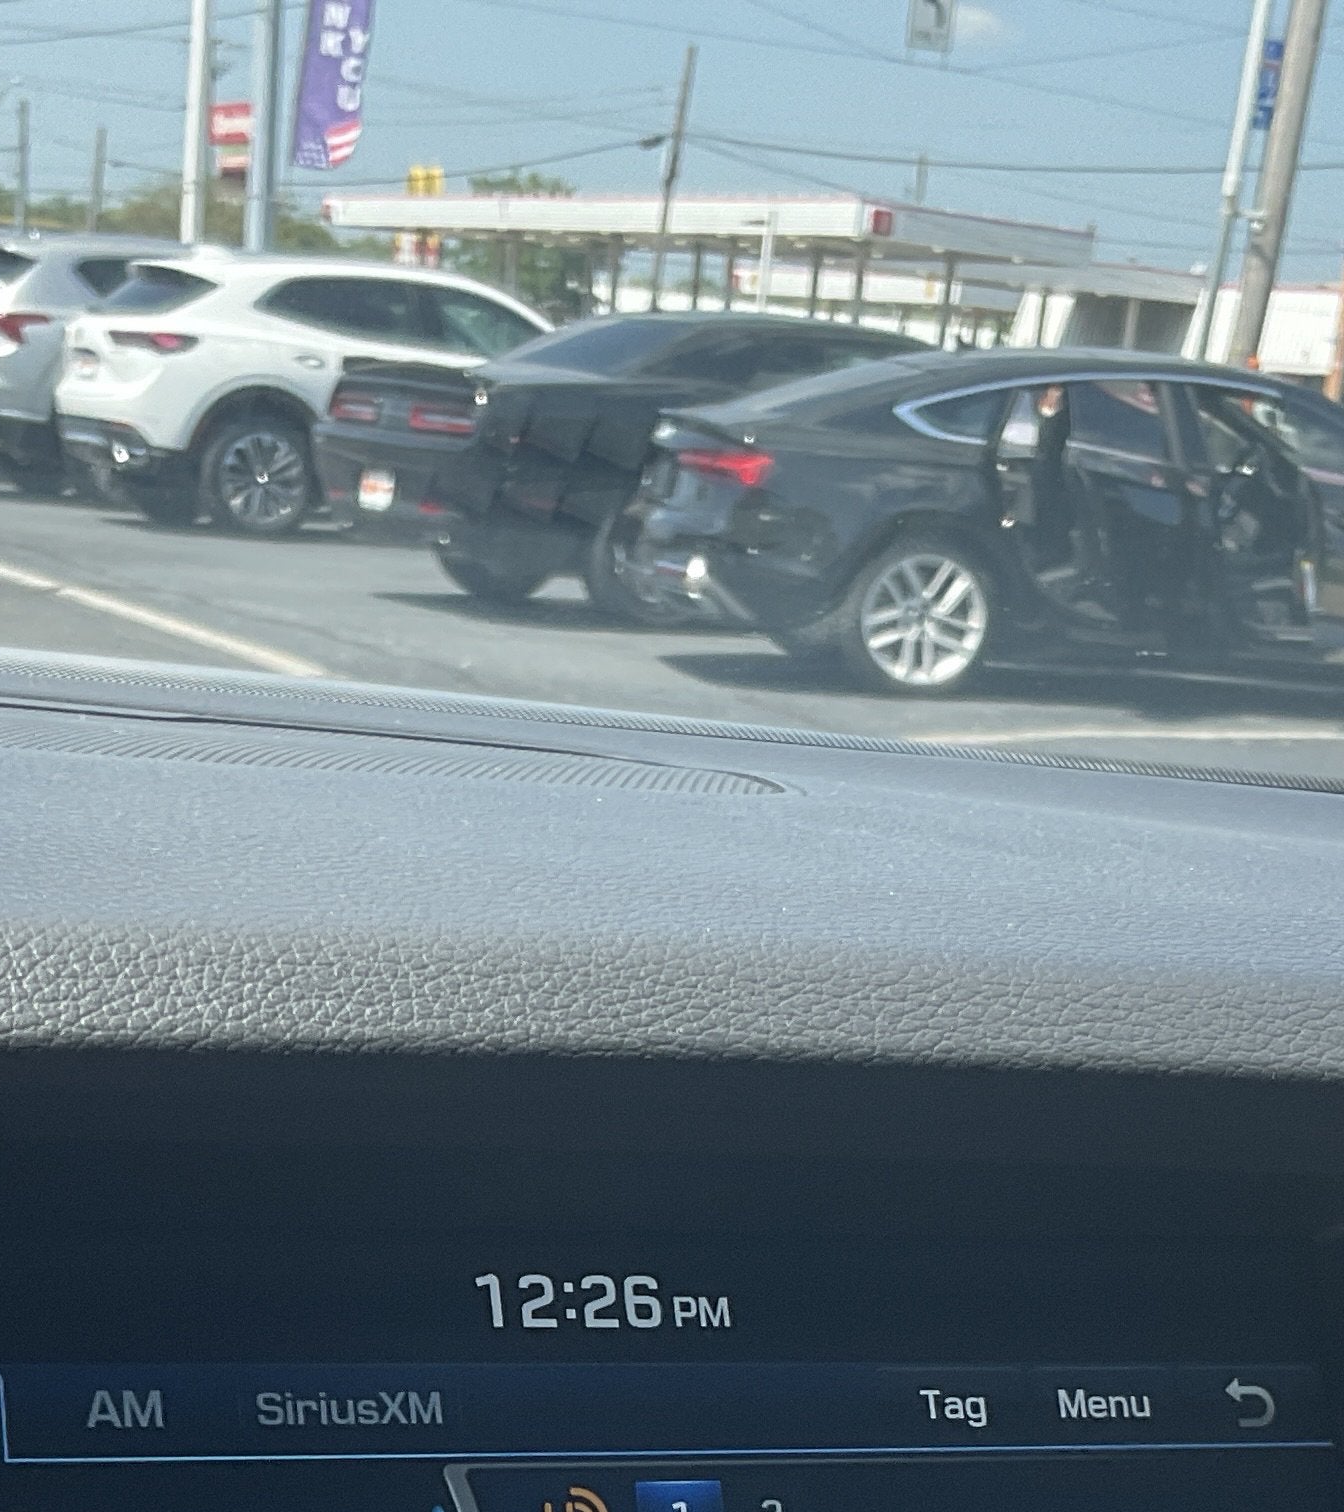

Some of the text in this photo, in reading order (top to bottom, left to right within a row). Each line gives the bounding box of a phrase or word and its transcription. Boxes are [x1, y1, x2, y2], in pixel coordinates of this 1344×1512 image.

[475, 1274, 730, 1329] 12:26 PM
[87, 1391, 164, 1428] AM
[256, 1391, 444, 1426] SiriusXM
[919, 1389, 988, 1427] Tag
[1058, 1390, 1151, 1419] Menu
